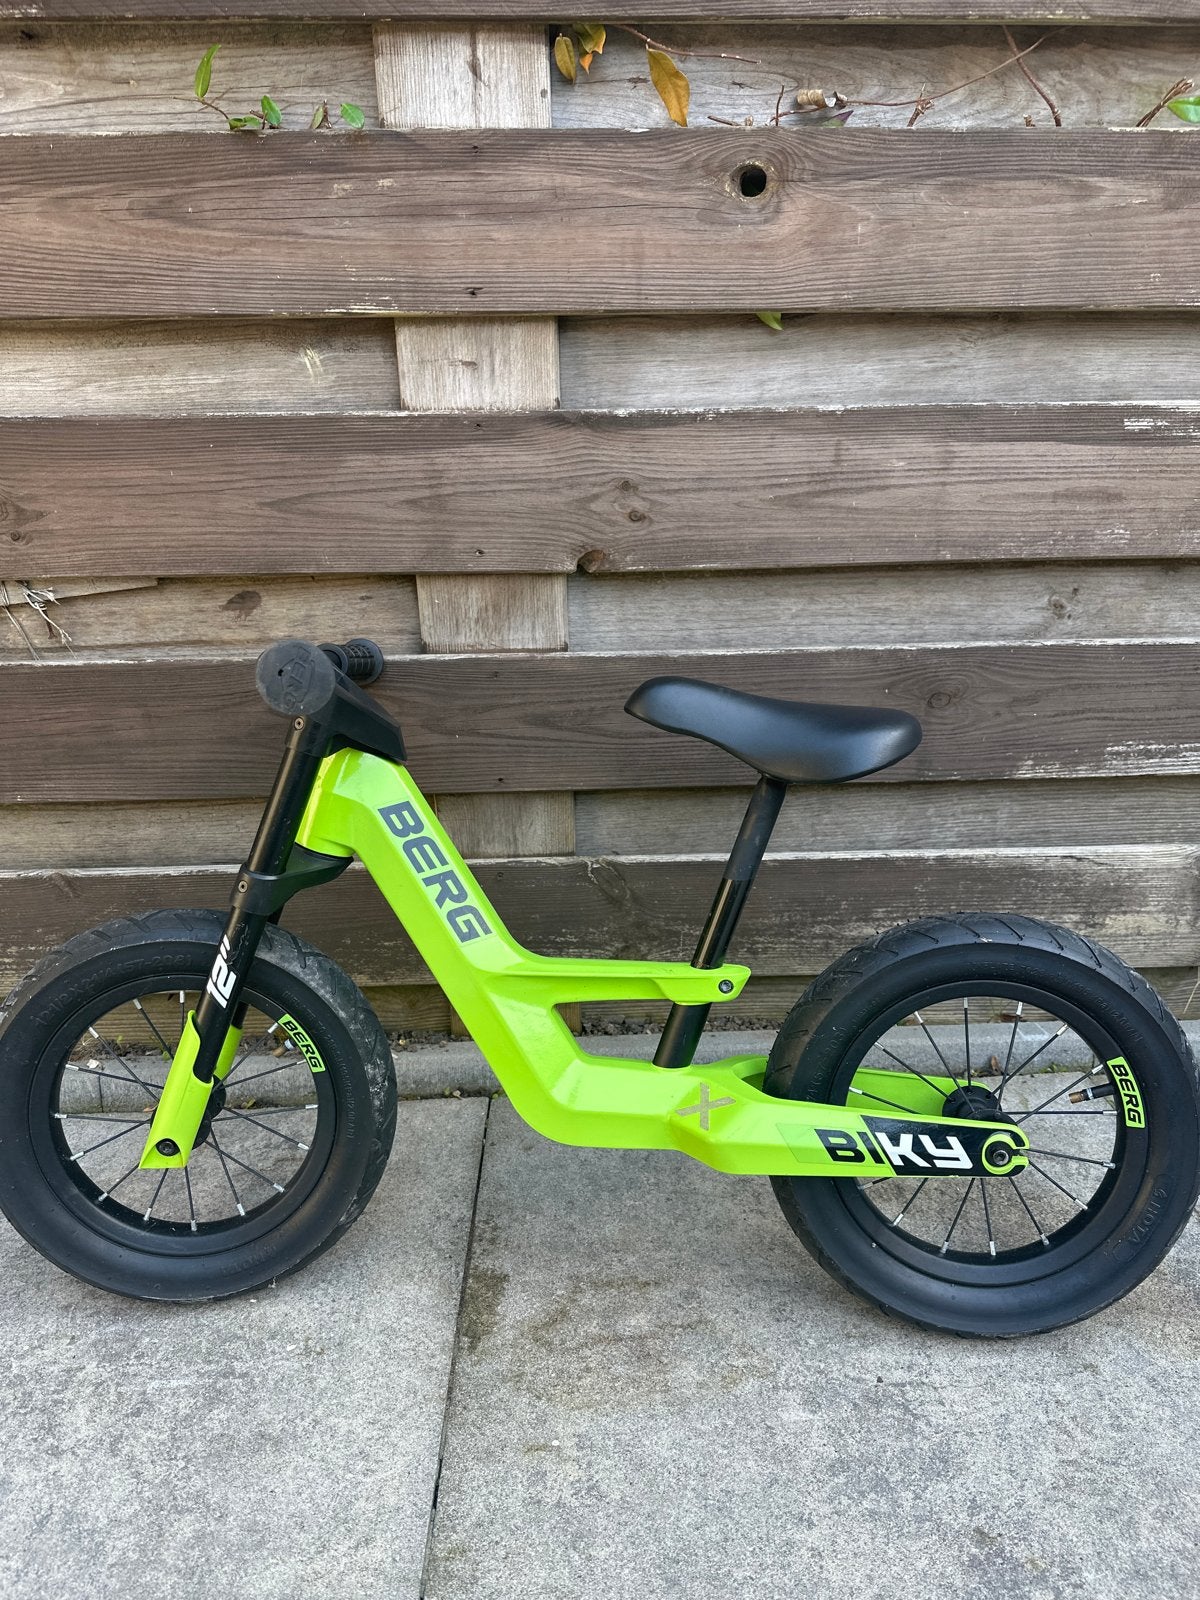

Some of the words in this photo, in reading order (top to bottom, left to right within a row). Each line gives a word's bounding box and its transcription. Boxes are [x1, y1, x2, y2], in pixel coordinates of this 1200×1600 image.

[378, 801, 493, 943] BERG
[206, 934, 237, 1009] 12"
[282, 1020, 322, 1068] BERG
[1111, 1065, 1142, 1124] BERG
[813, 1128, 973, 1169] BIKY
